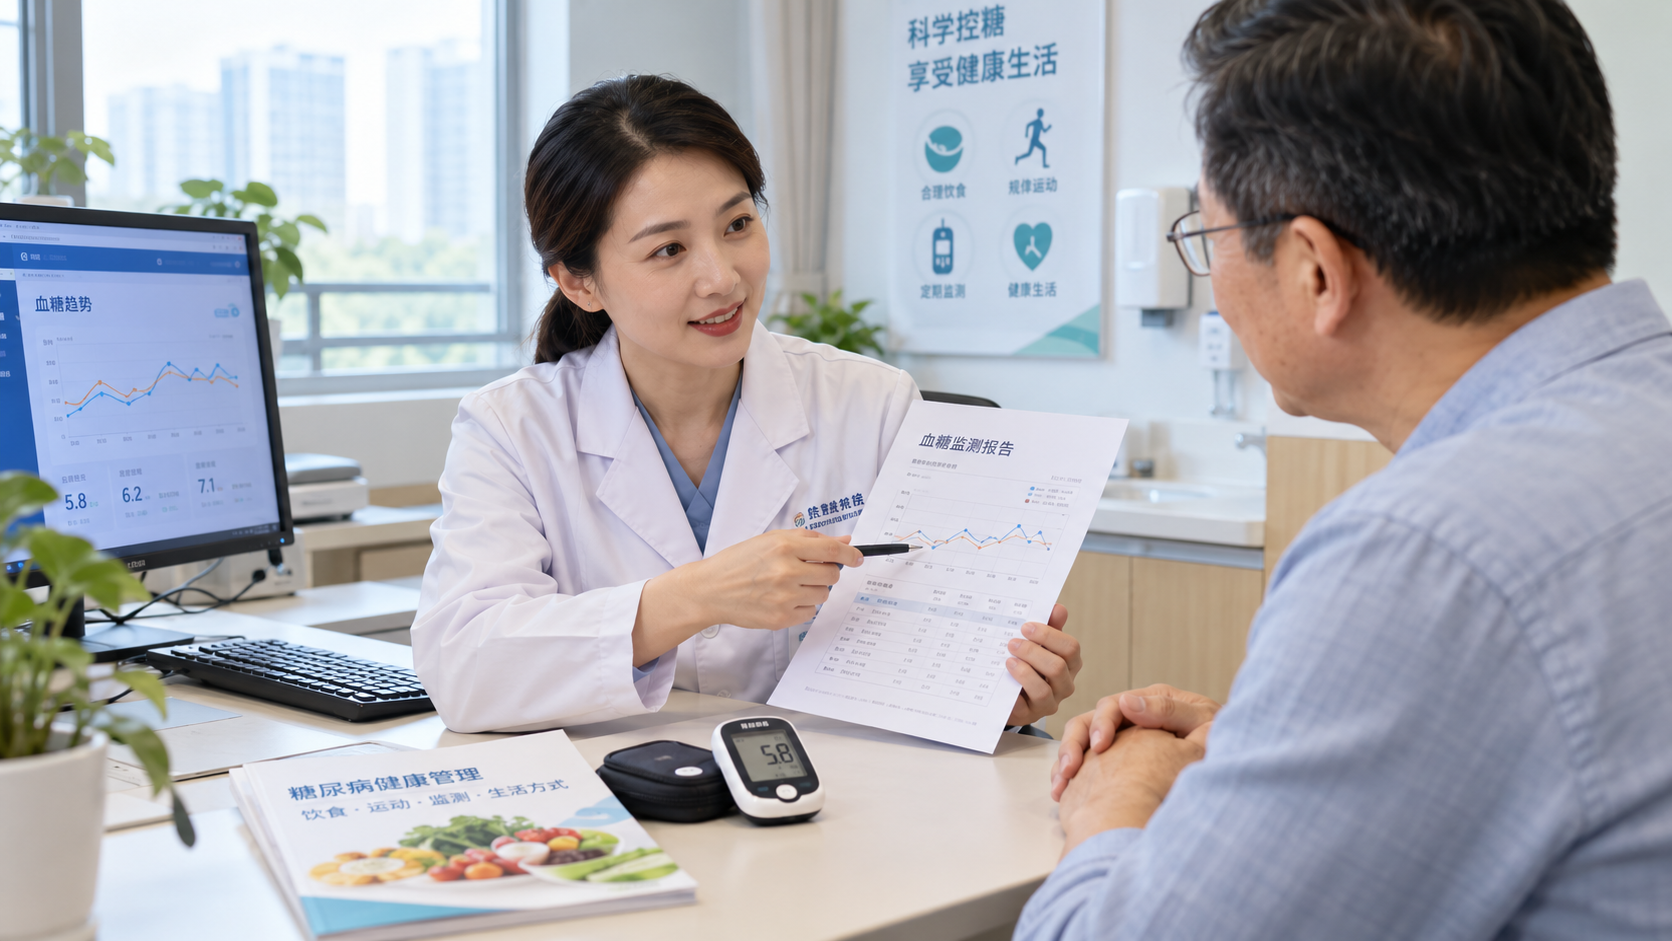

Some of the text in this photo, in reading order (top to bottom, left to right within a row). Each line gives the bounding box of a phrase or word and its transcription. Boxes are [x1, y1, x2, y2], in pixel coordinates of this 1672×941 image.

[908, 4, 1005, 49] 科学控糖
[908, 42, 1058, 93] 享受健康生活
[921, 182, 966, 201] 合理饮食
[920, 283, 966, 299] 定期监测
[1008, 281, 1057, 298] 健康生活
[35, 295, 93, 313] 血糖趋势
[918, 433, 1015, 457] 血糖监测报告
[122, 486, 143, 503] 6.2
[197, 477, 215, 494] 7.1
[65, 492, 87, 511] 5.8
[760, 743, 794, 765] 5.8
[287, 767, 484, 801] 糖尿病健康管理
